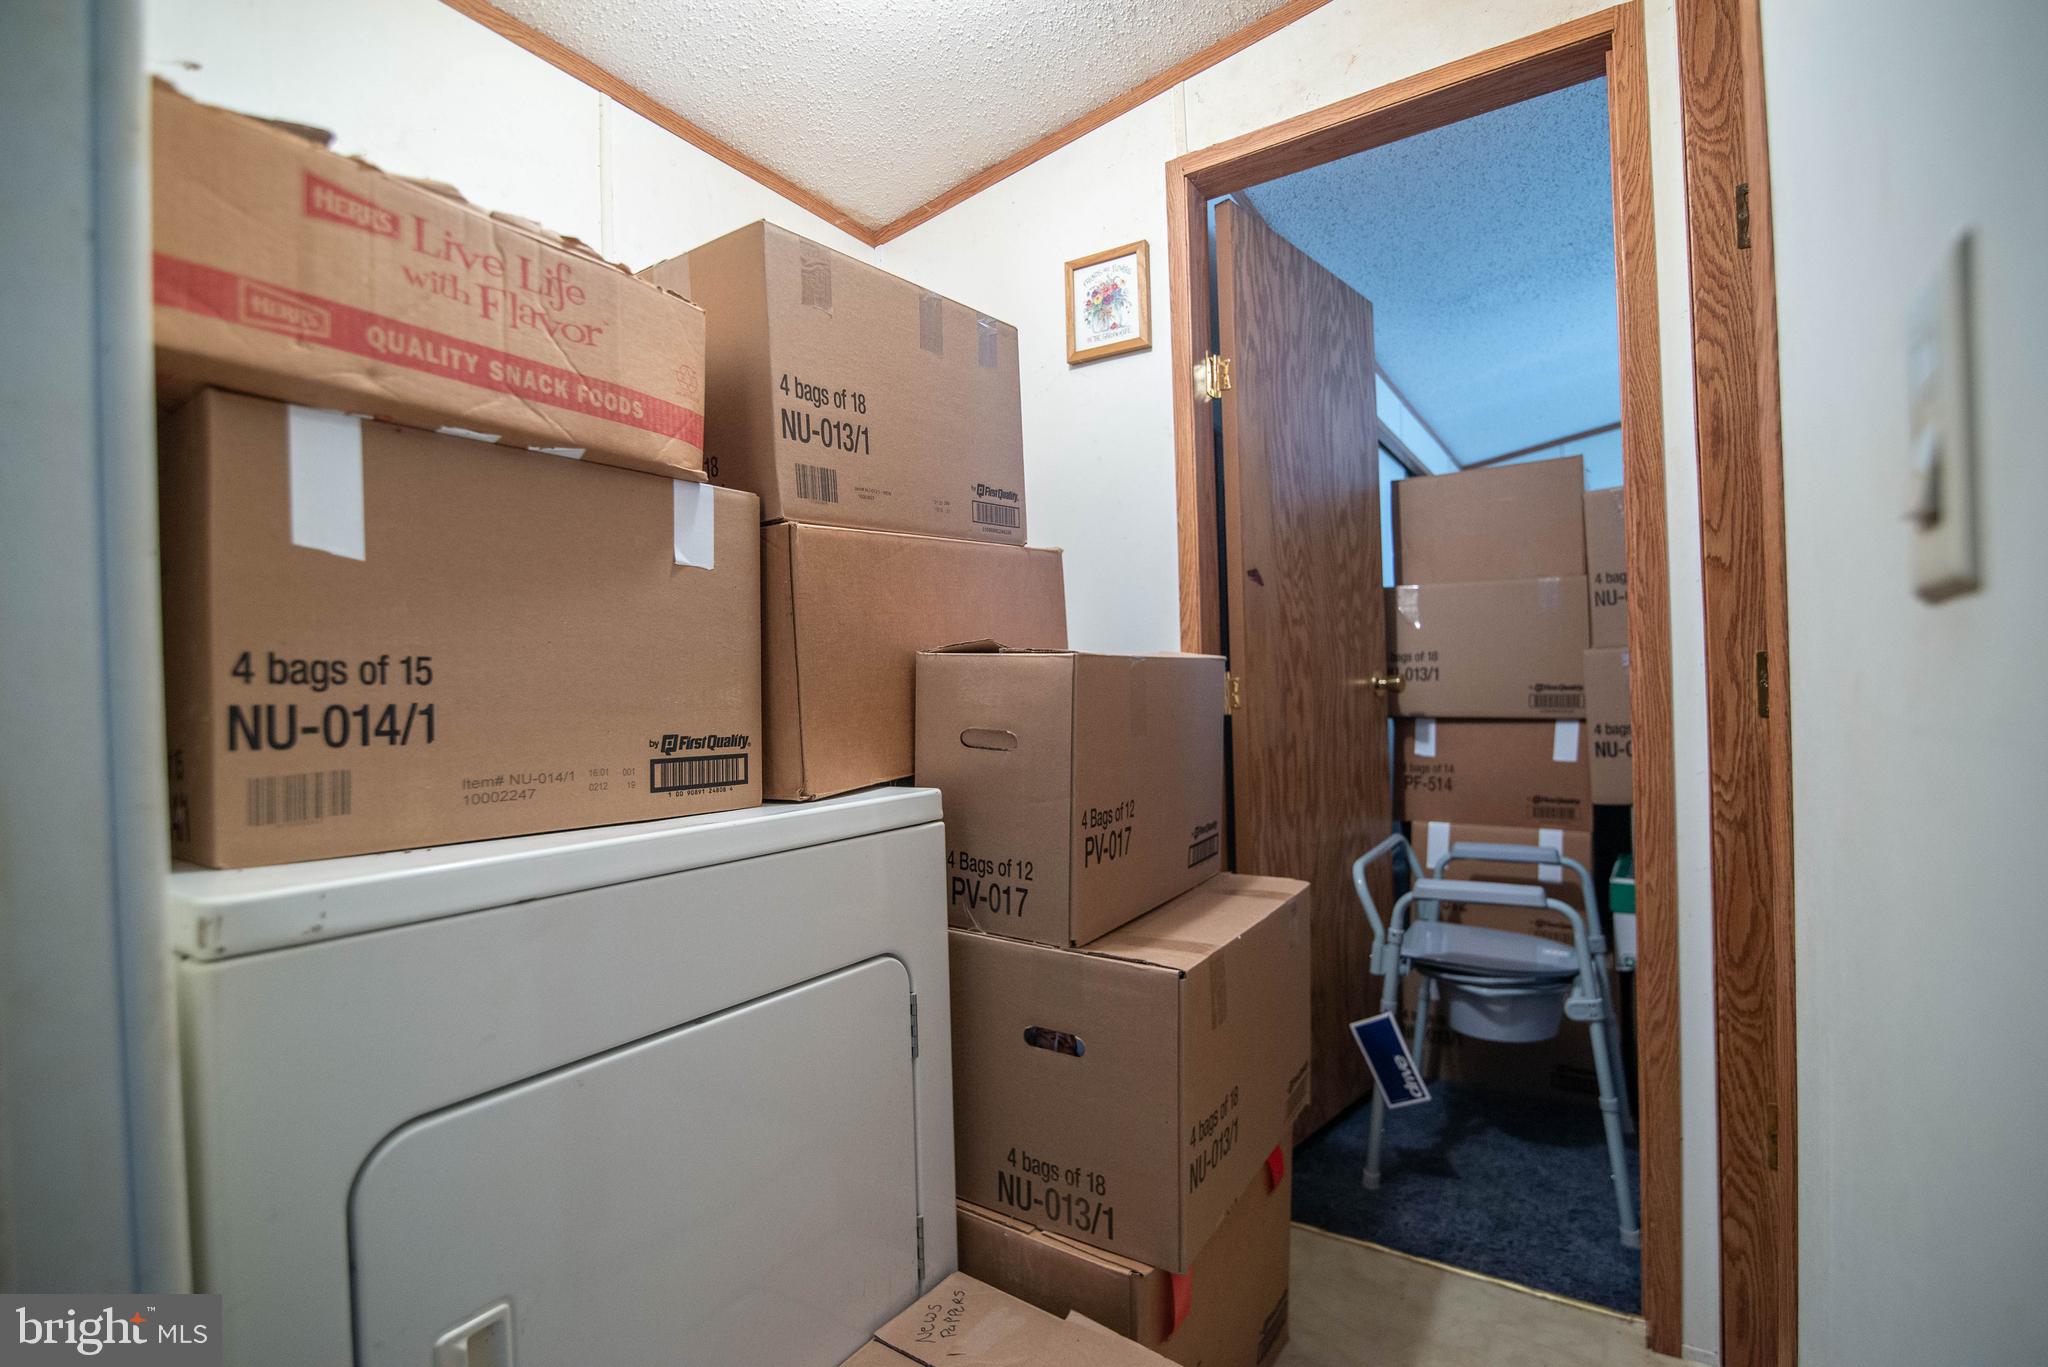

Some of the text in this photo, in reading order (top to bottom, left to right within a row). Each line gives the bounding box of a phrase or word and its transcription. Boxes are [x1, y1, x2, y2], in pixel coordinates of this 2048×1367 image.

[412, 217, 586, 312] Live Life
[403, 264, 603, 347] with Flavor
[366, 325, 644, 420] QUALITY SNACK FOODS
[780, 373, 867, 415] 4 bags of 18
[781, 408, 870, 455] NU-013/1
[1595, 590, 1627, 607] NU-
[1606, 572, 1627, 585] bag
[232, 651, 433, 692] 4 bags of 15
[228, 702, 436, 751] NU-014/1
[649, 739, 659, 749] by
[462, 771, 575, 790] Item# NU-014/1
[464, 789, 536, 806] 10002247
[1081, 799, 1135, 830] 4 Bags of 12
[947, 850, 1033, 881] 4 Bags of 12
[1085, 826, 1132, 868] PV-017
[952, 877, 1029, 917] PV-017
[1190, 1085, 1239, 1146] 4 bags of 18
[1007, 1148, 1106, 1196] 4 bags of 18
[1189, 1119, 1239, 1194] NU-013/1
[998, 1170, 1115, 1240] NU-013/1
